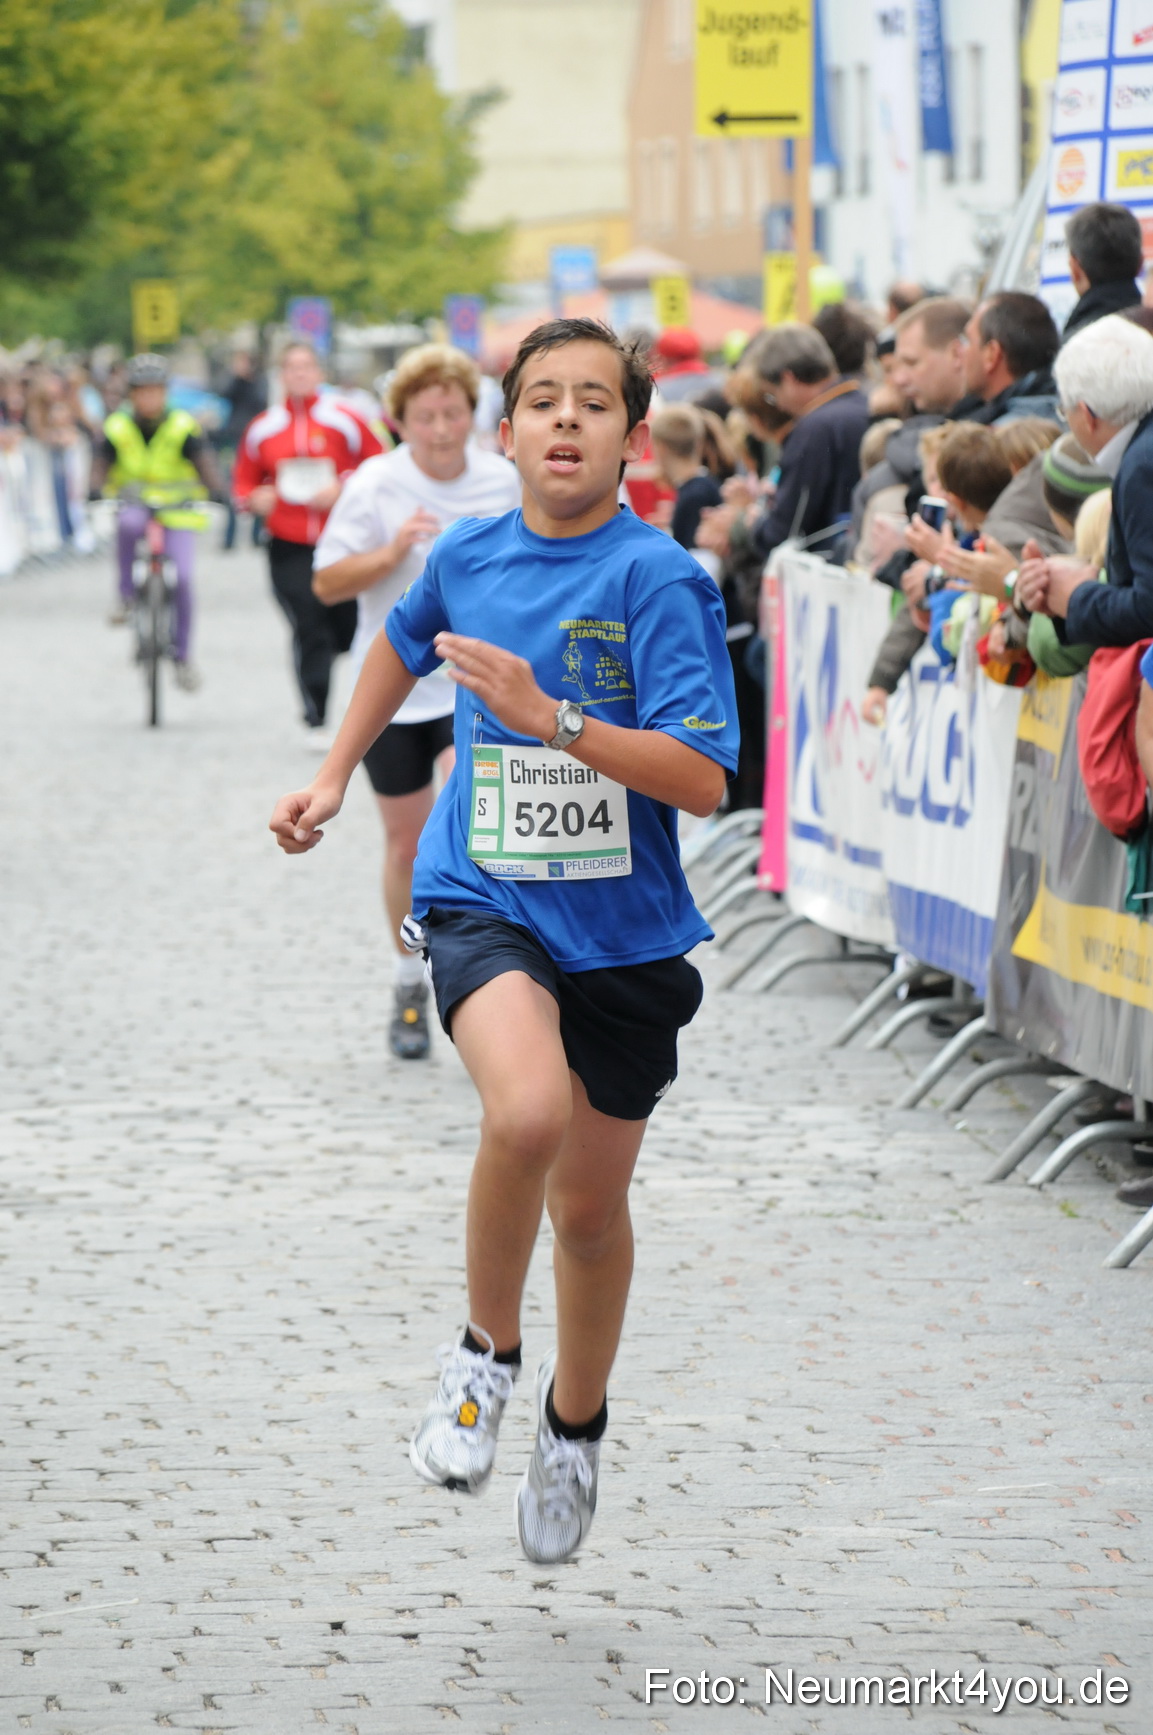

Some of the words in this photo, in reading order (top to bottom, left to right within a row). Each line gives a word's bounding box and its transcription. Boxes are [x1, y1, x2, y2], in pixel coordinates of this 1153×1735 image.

[698, 6, 807, 40] Jugend-
[728, 39, 779, 67] lauf
[559, 619, 626, 632] NEUMARKTER
[569, 629, 627, 643] STADTLAUF
[597, 670, 602, 679] 5
[510, 759, 599, 784] Christian
[514, 800, 613, 837] 5204
[484, 864, 524, 873] BOCK
[566, 857, 628, 871] PFLEIDERER
